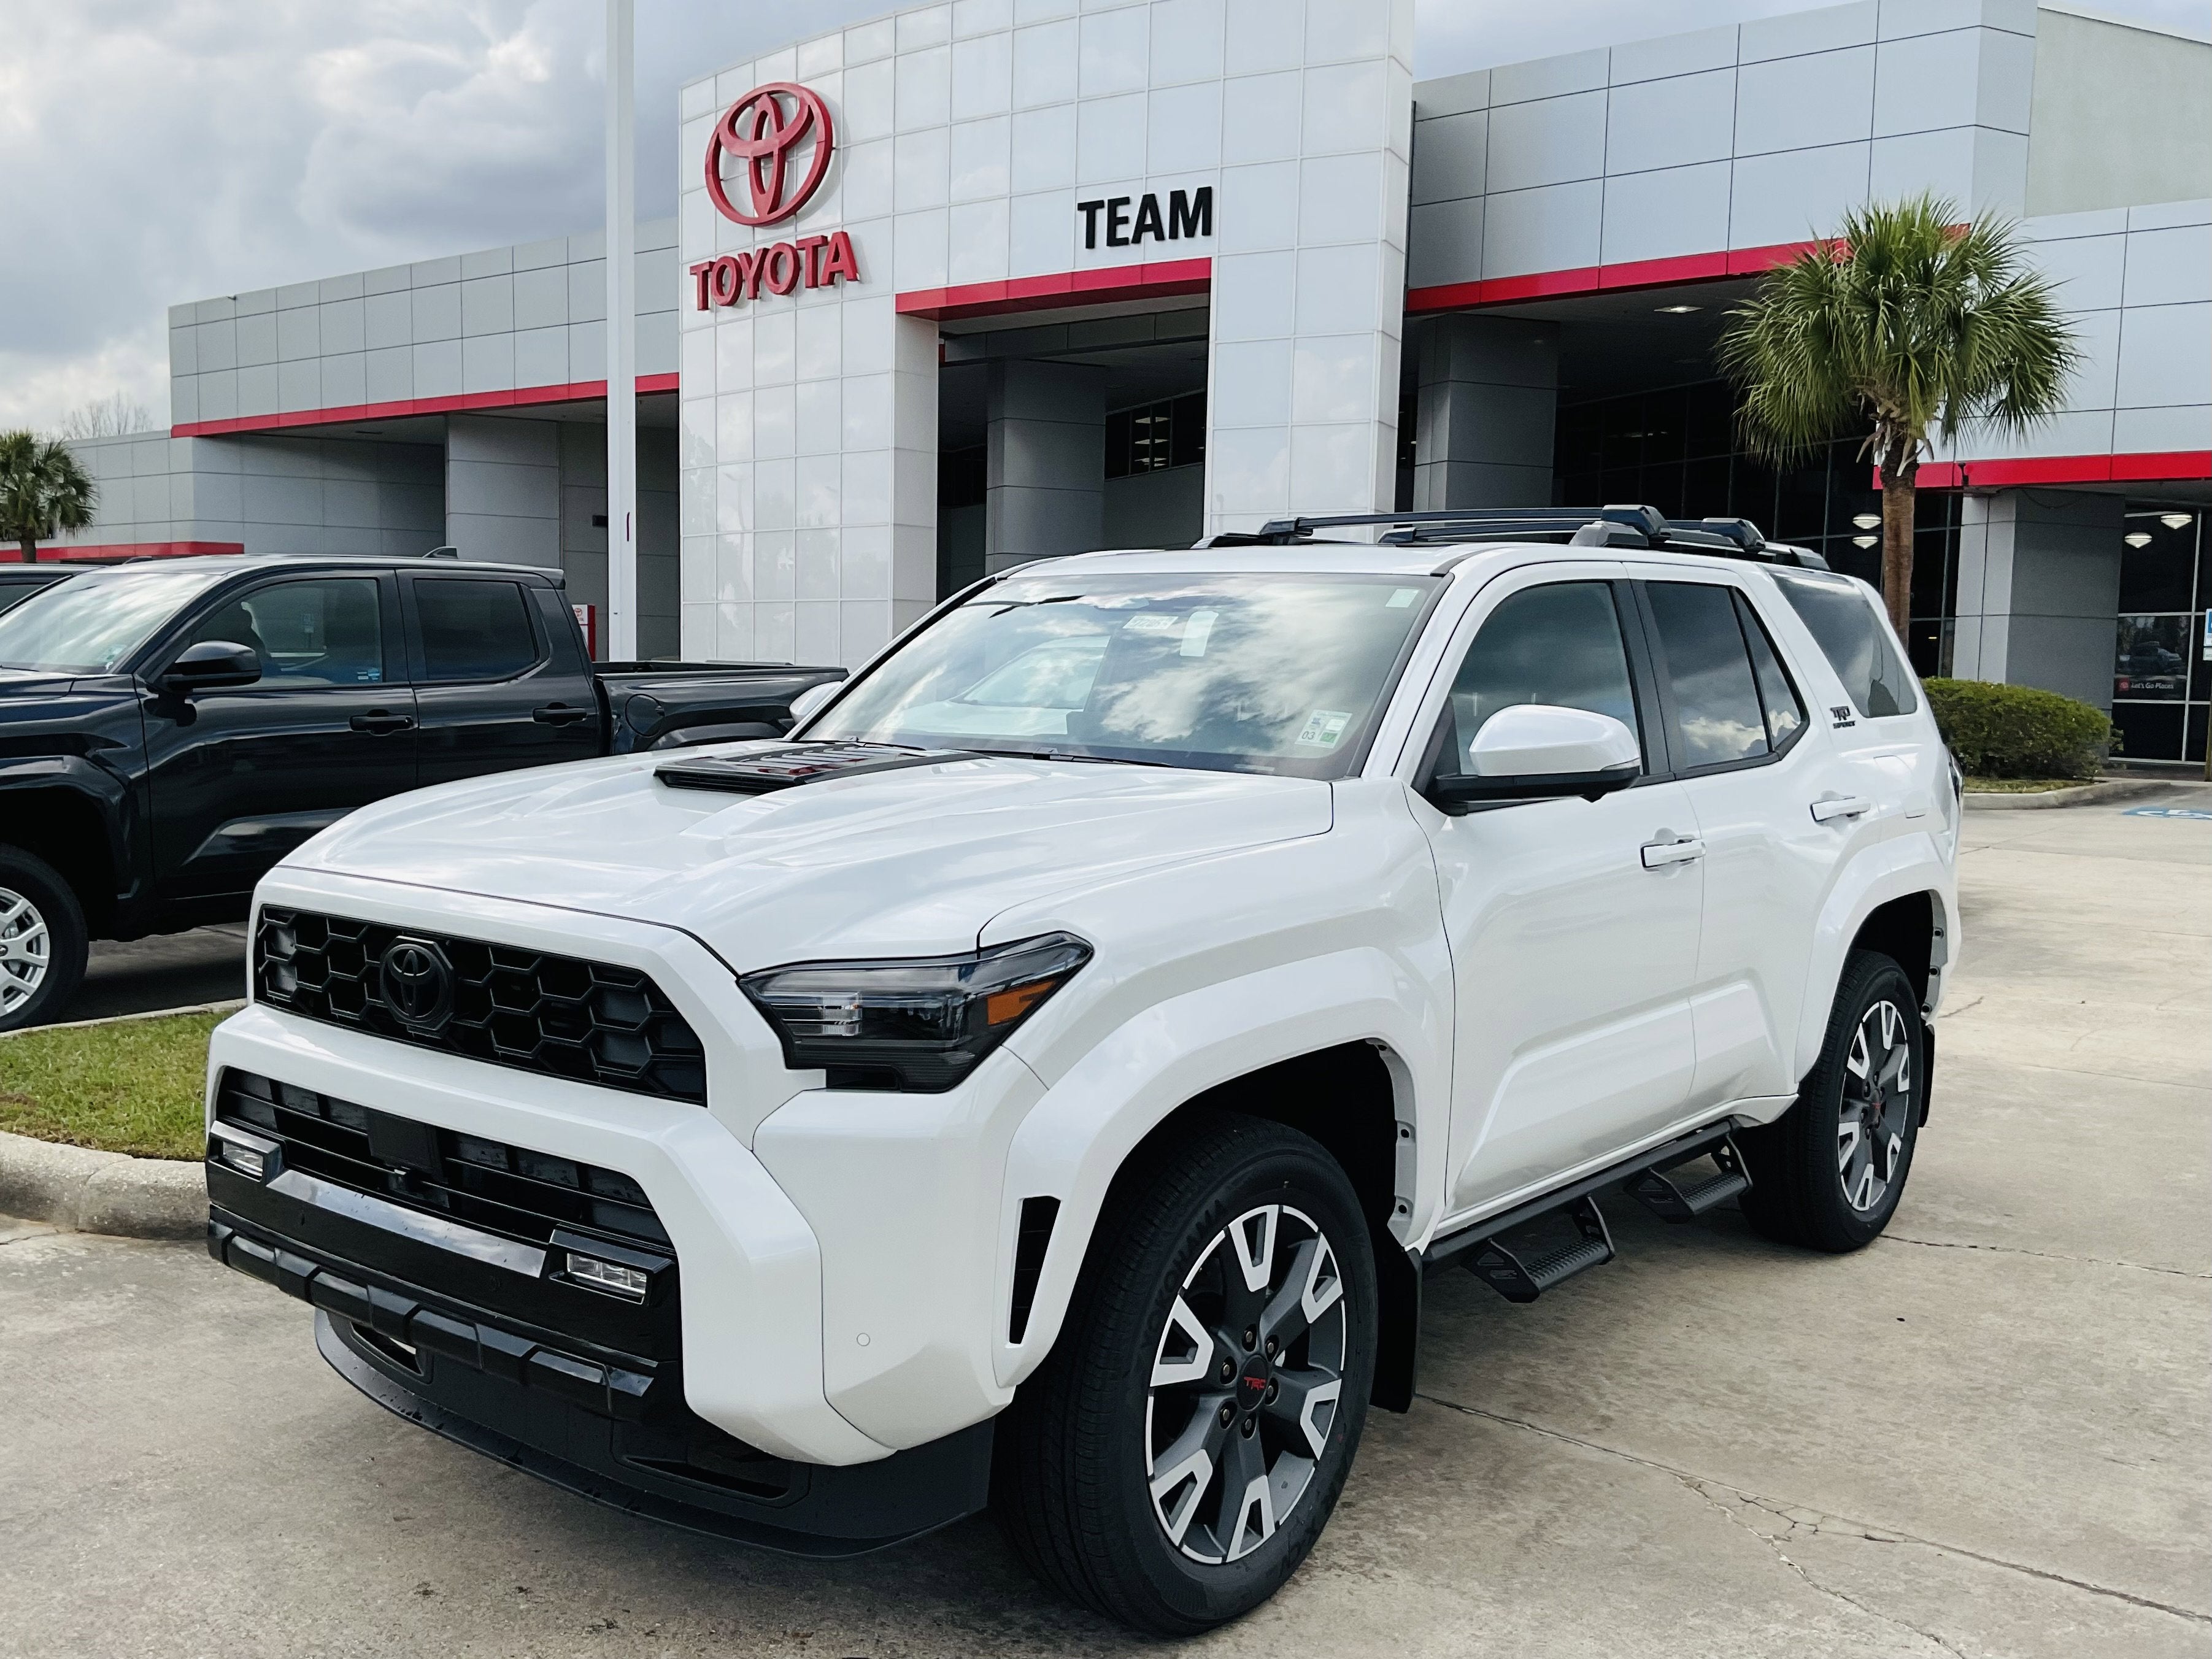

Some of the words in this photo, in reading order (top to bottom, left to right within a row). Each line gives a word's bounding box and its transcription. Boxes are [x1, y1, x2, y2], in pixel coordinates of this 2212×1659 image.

[1077, 186, 1213, 249] TEAM
[690, 231, 860, 311] TOYOTA
[1301, 731, 1316, 740] 03
[1830, 706, 1851, 721] TRD
[1139, 1196, 1228, 1350] YOKOHAMA
